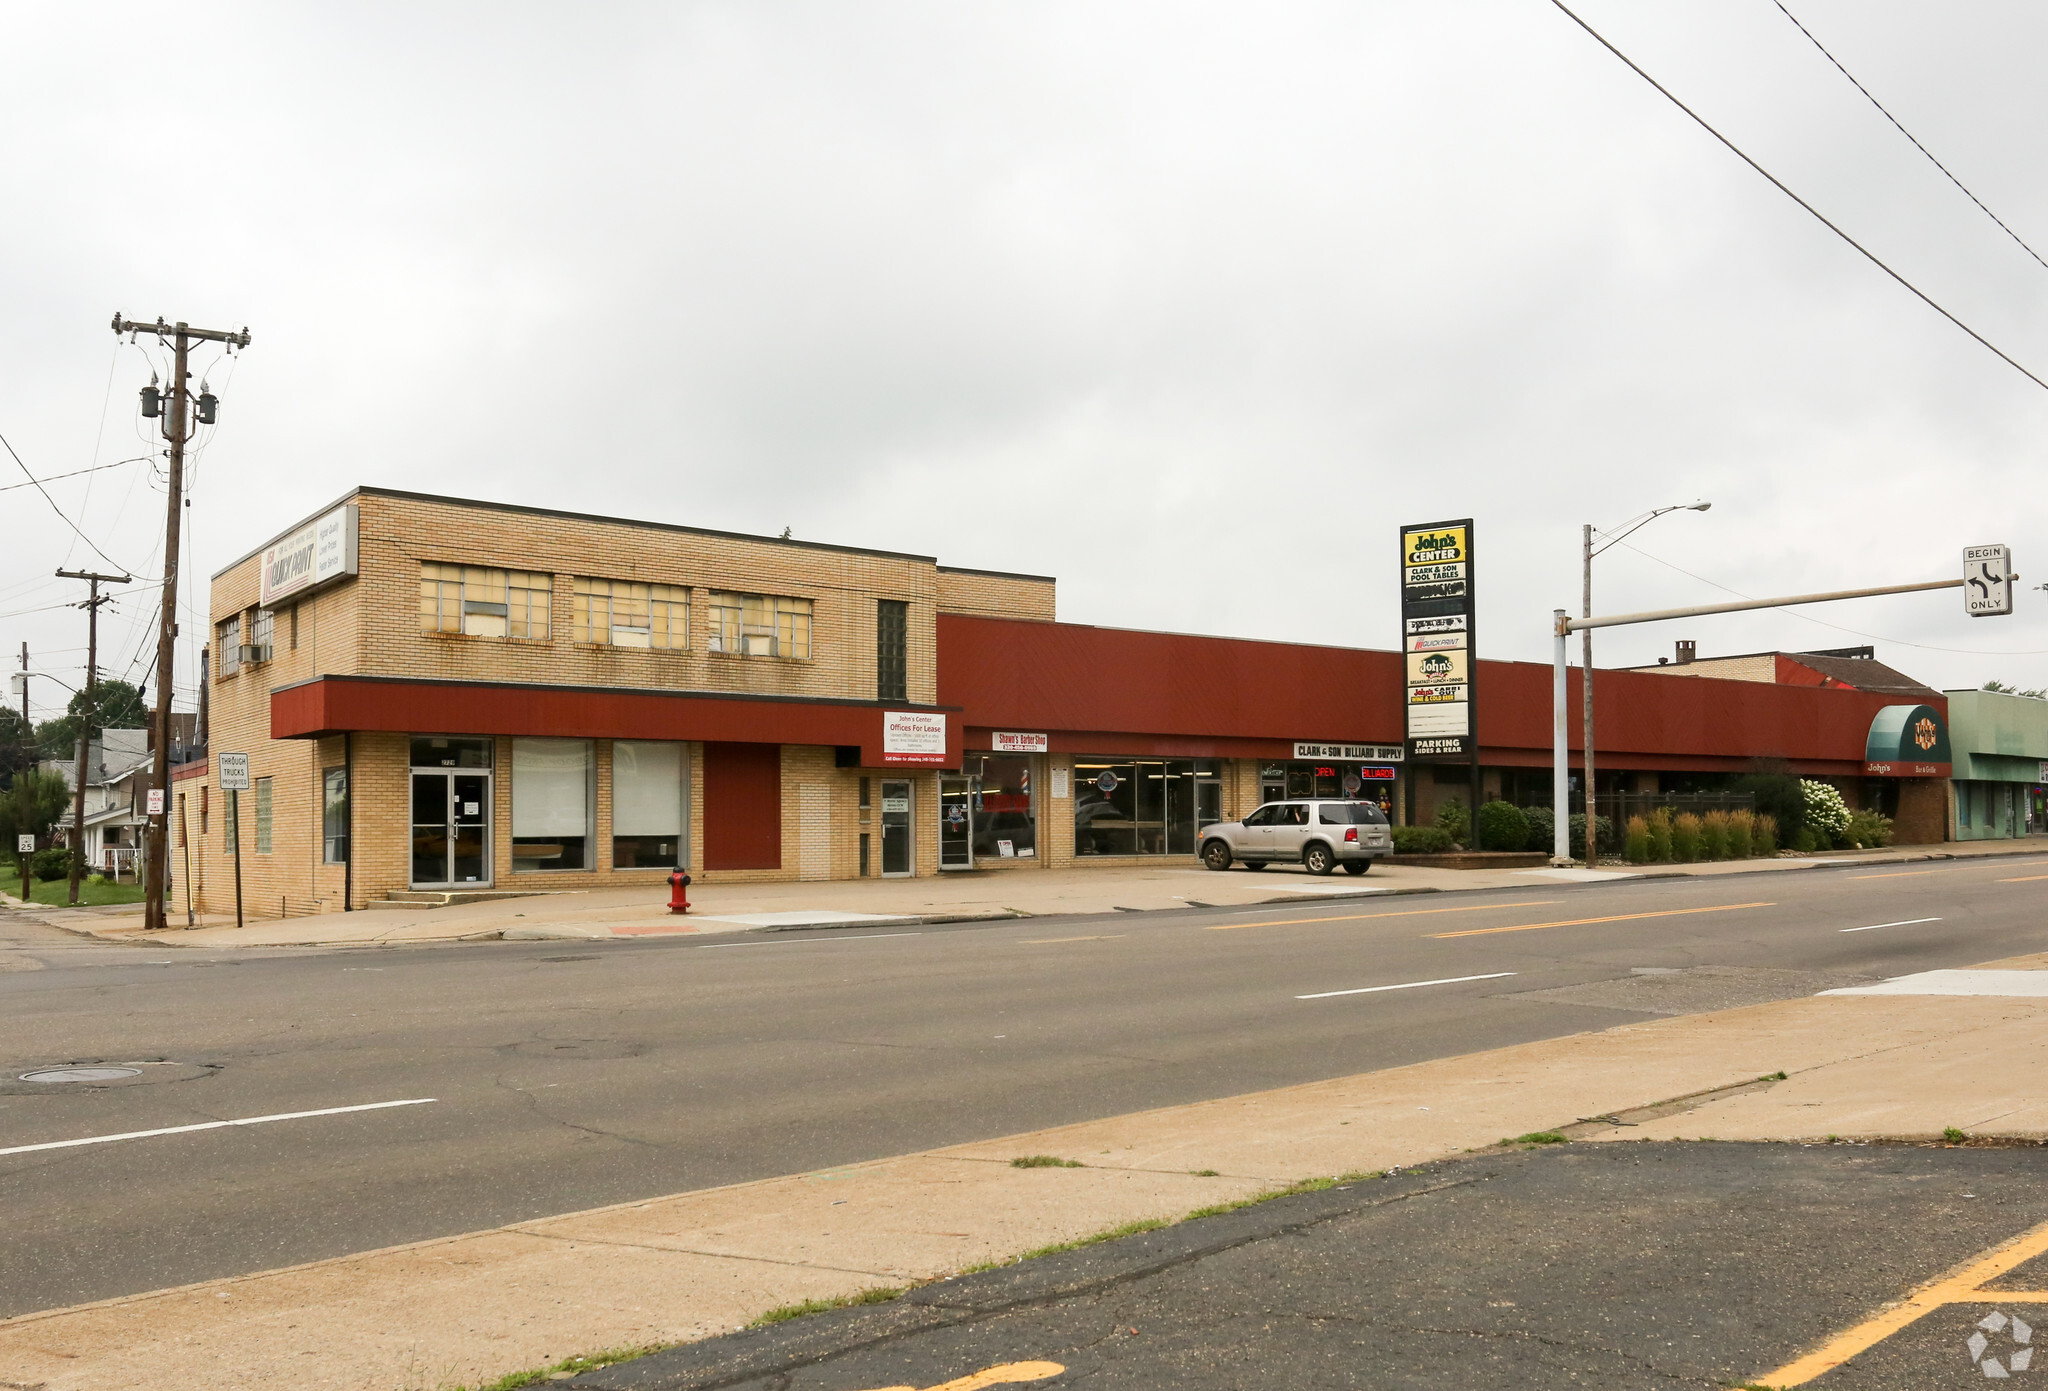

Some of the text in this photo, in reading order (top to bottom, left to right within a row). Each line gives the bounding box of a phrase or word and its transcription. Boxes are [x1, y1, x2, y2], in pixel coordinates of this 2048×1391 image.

[1415, 534, 1457, 551] John's
[1413, 549, 1456, 562] CENTER
[1968, 548, 2001, 558] BEGIN
[271, 543, 314, 587] QUICK PRINT
[1412, 567, 1433, 575] CLARK
[1411, 571, 1459, 582] POOL TABLES
[1971, 600, 2001, 609] ONLY
[1423, 638, 1459, 648] QUICK PRINT
[1420, 660, 1453, 674] John's
[1414, 688, 1434, 697] John's
[999, 734, 1046, 745] Shawn's Barber Shop
[1416, 739, 1460, 748] PARKING
[1298, 746, 1321, 757] CLARK
[1328, 746, 1342, 757] SON
[1344, 748, 1375, 758] BILLIARD
[1377, 749, 1402, 759] SUPPLY
[221, 757, 247, 766] THROUGH
[1315, 768, 1336, 777] OPEN
[1362, 768, 1394, 778] BILLIARDS
[1867, 764, 1891, 774] John's
